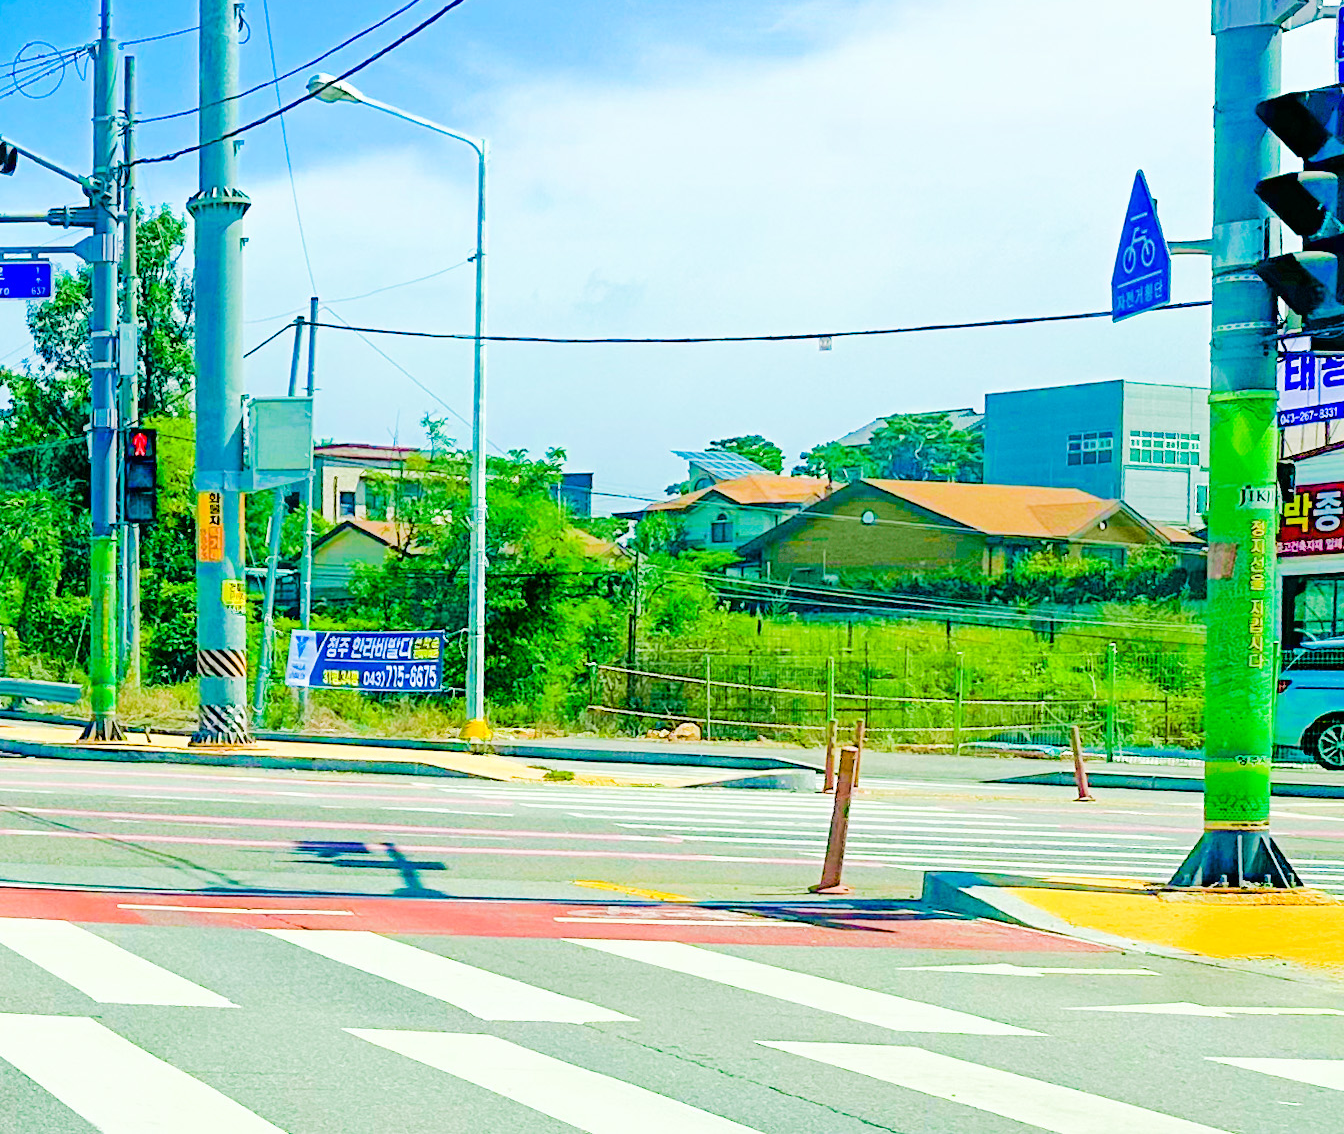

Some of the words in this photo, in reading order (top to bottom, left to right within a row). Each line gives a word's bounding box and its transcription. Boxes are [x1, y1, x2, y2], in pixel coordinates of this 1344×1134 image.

[326, 636, 351, 658] 청주
[350, 636, 414, 660] 한라비발디
[363, 664, 437, 688] 043)715-6675
